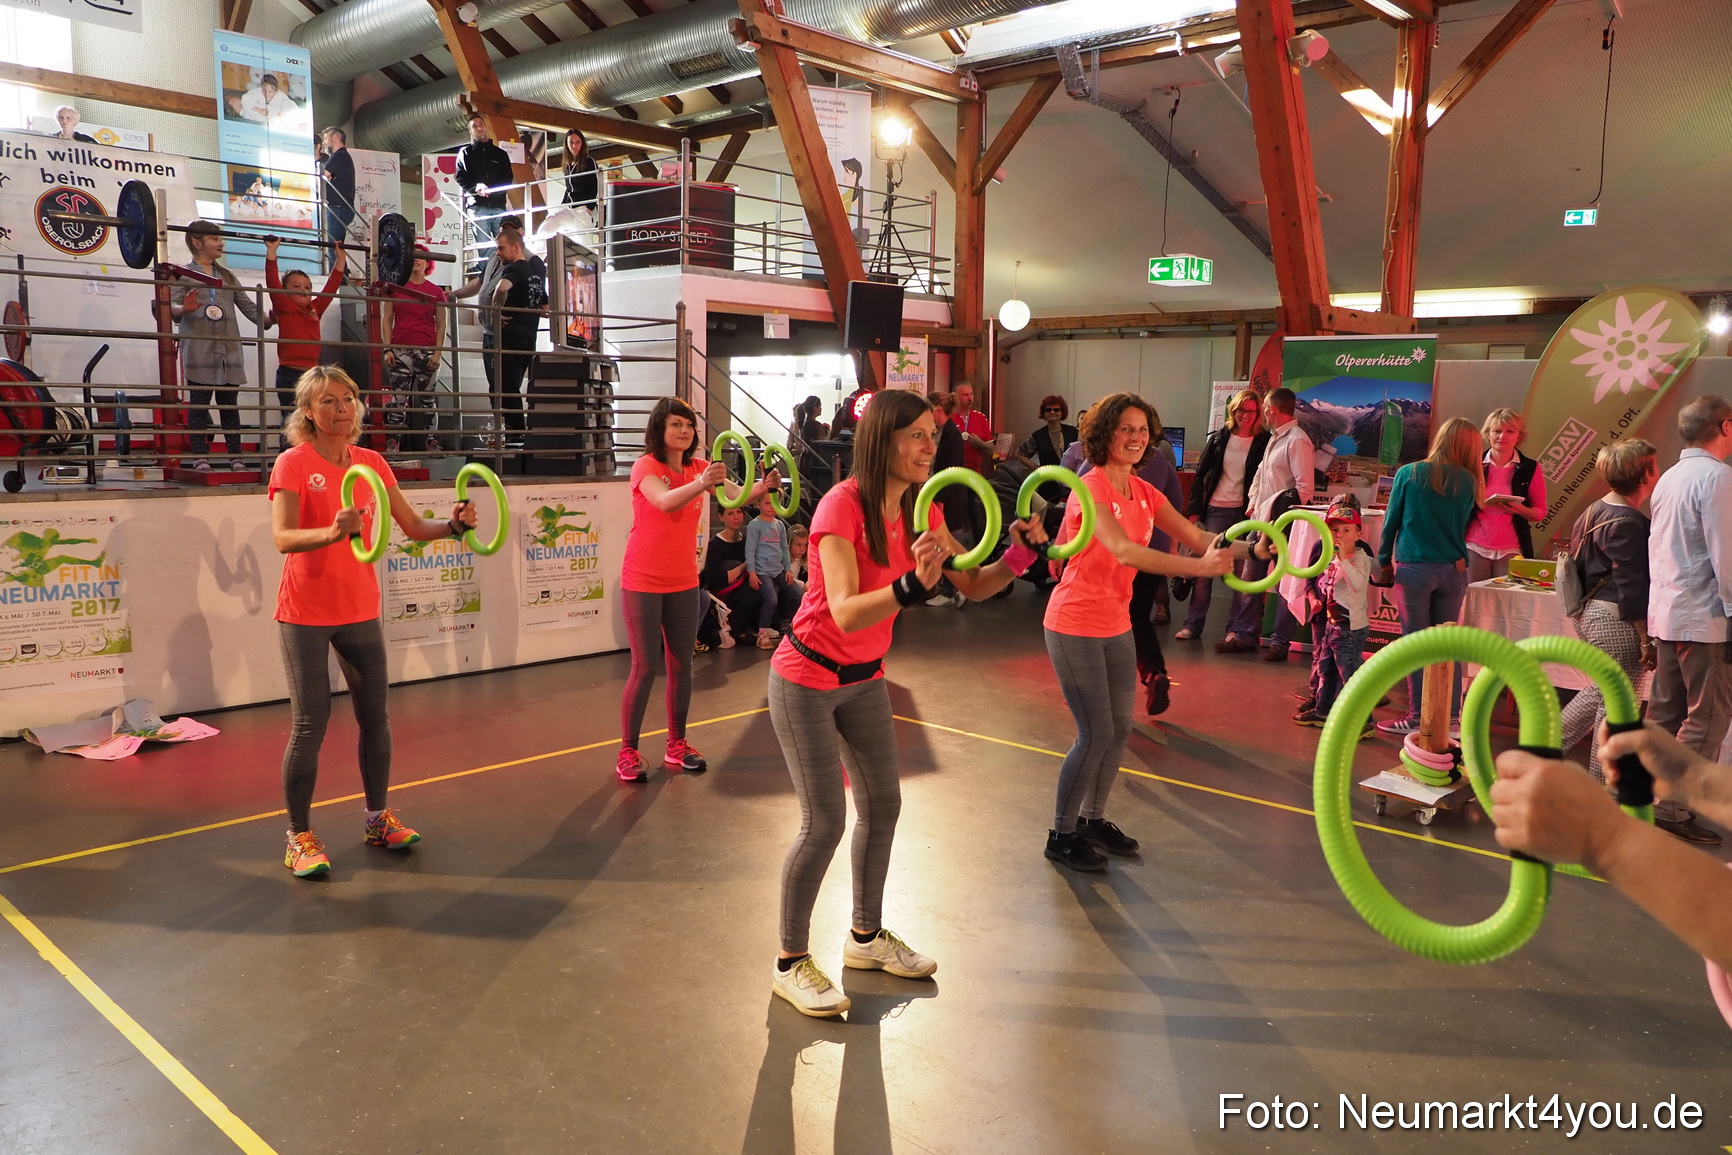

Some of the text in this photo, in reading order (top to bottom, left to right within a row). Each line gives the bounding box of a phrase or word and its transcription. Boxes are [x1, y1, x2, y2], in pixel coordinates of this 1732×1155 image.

[47, 147, 177, 178] willkommen
[40, 167, 96, 189] beim
[631, 229, 709, 244] BODY STEET
[907, 366, 925, 374] FIT IN
[1335, 353, 1413, 373] Olpererhütte
[888, 374, 925, 382] NEUMARKT
[908, 382, 924, 392] 2017
[1547, 422, 1581, 461] DAV
[1551, 430, 1595, 482] Deutscher Alpenverein
[1535, 495, 1568, 531] Sektion
[1618, 407, 1641, 429] OPf.
[563, 530, 599, 546] FIT IN
[433, 540, 456, 555] FIT
[526, 543, 598, 561] NEUMARKT
[387, 552, 474, 573] NEUMARKT
[570, 556, 598, 571] 2017
[59, 563, 120, 584] FIT IN
[440, 566, 474, 582] 2017
[71, 597, 121, 617] 2017
[567, 609, 594, 618] NEUMARKT
[438, 623, 470, 633] NEUMARKT
[70, 667, 116, 679] NEUMARKT
